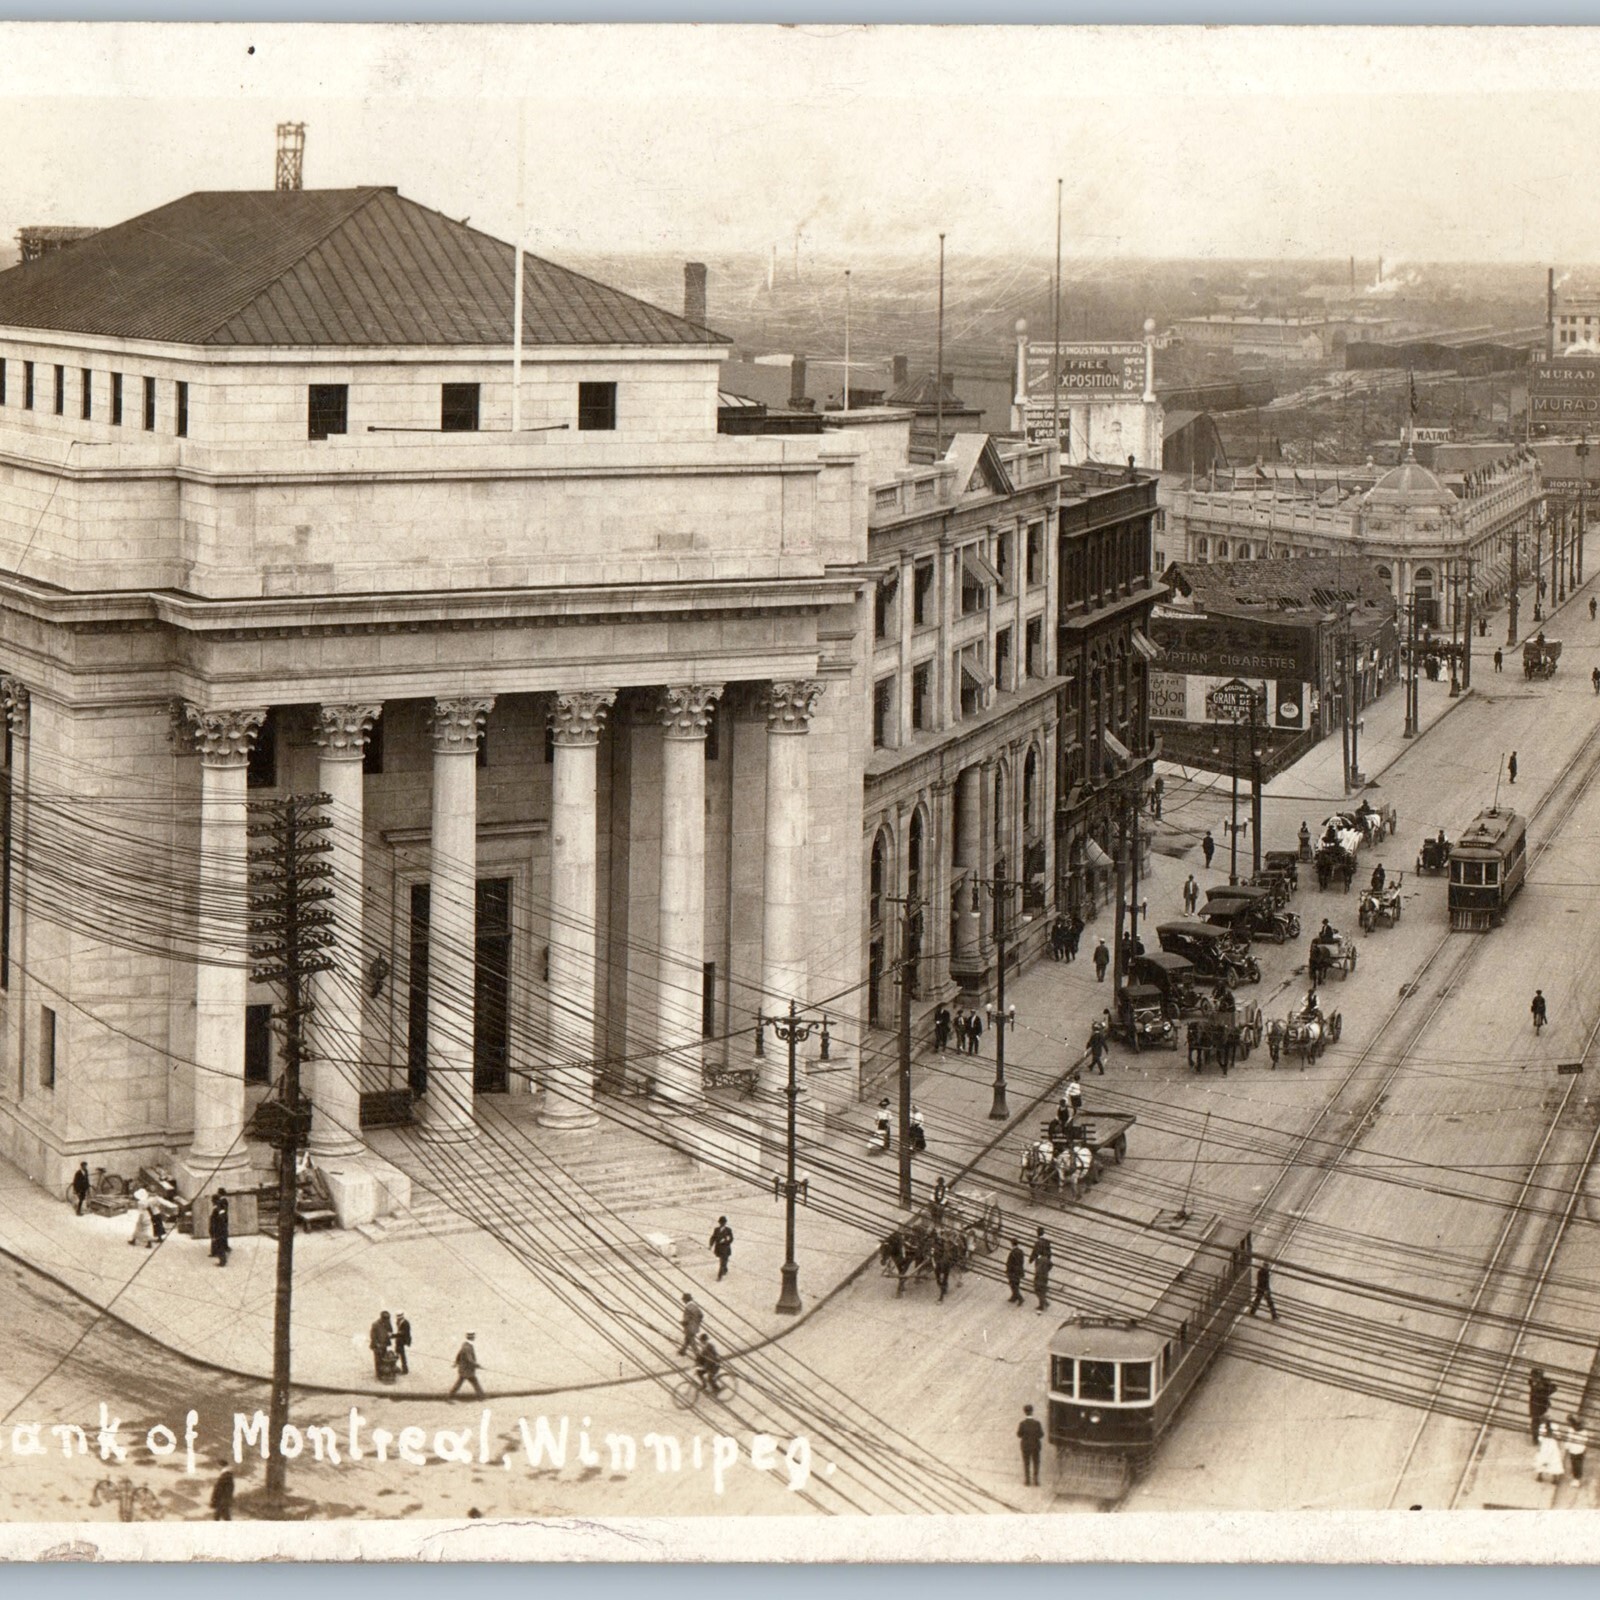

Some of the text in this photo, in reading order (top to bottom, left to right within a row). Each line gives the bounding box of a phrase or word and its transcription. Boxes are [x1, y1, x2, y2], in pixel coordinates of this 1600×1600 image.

[1030, 346, 1142, 355] WINNIPG INDUSTRIAL BUREAU
[1070, 360, 1104, 369] FREE
[1123, 357, 1145, 365] OPEN
[1124, 366, 1132, 377] 9
[1540, 370, 1595, 379] MURAD
[1534, 399, 1598, 411] MURAD
[1219, 654, 1296, 669] CIGARETTES
[1150, 678, 1179, 689] rgaret
[1149, 689, 1185, 707] ngton
[1213, 692, 1259, 705] GRAIN BET
[1152, 708, 1184, 717] DLING
